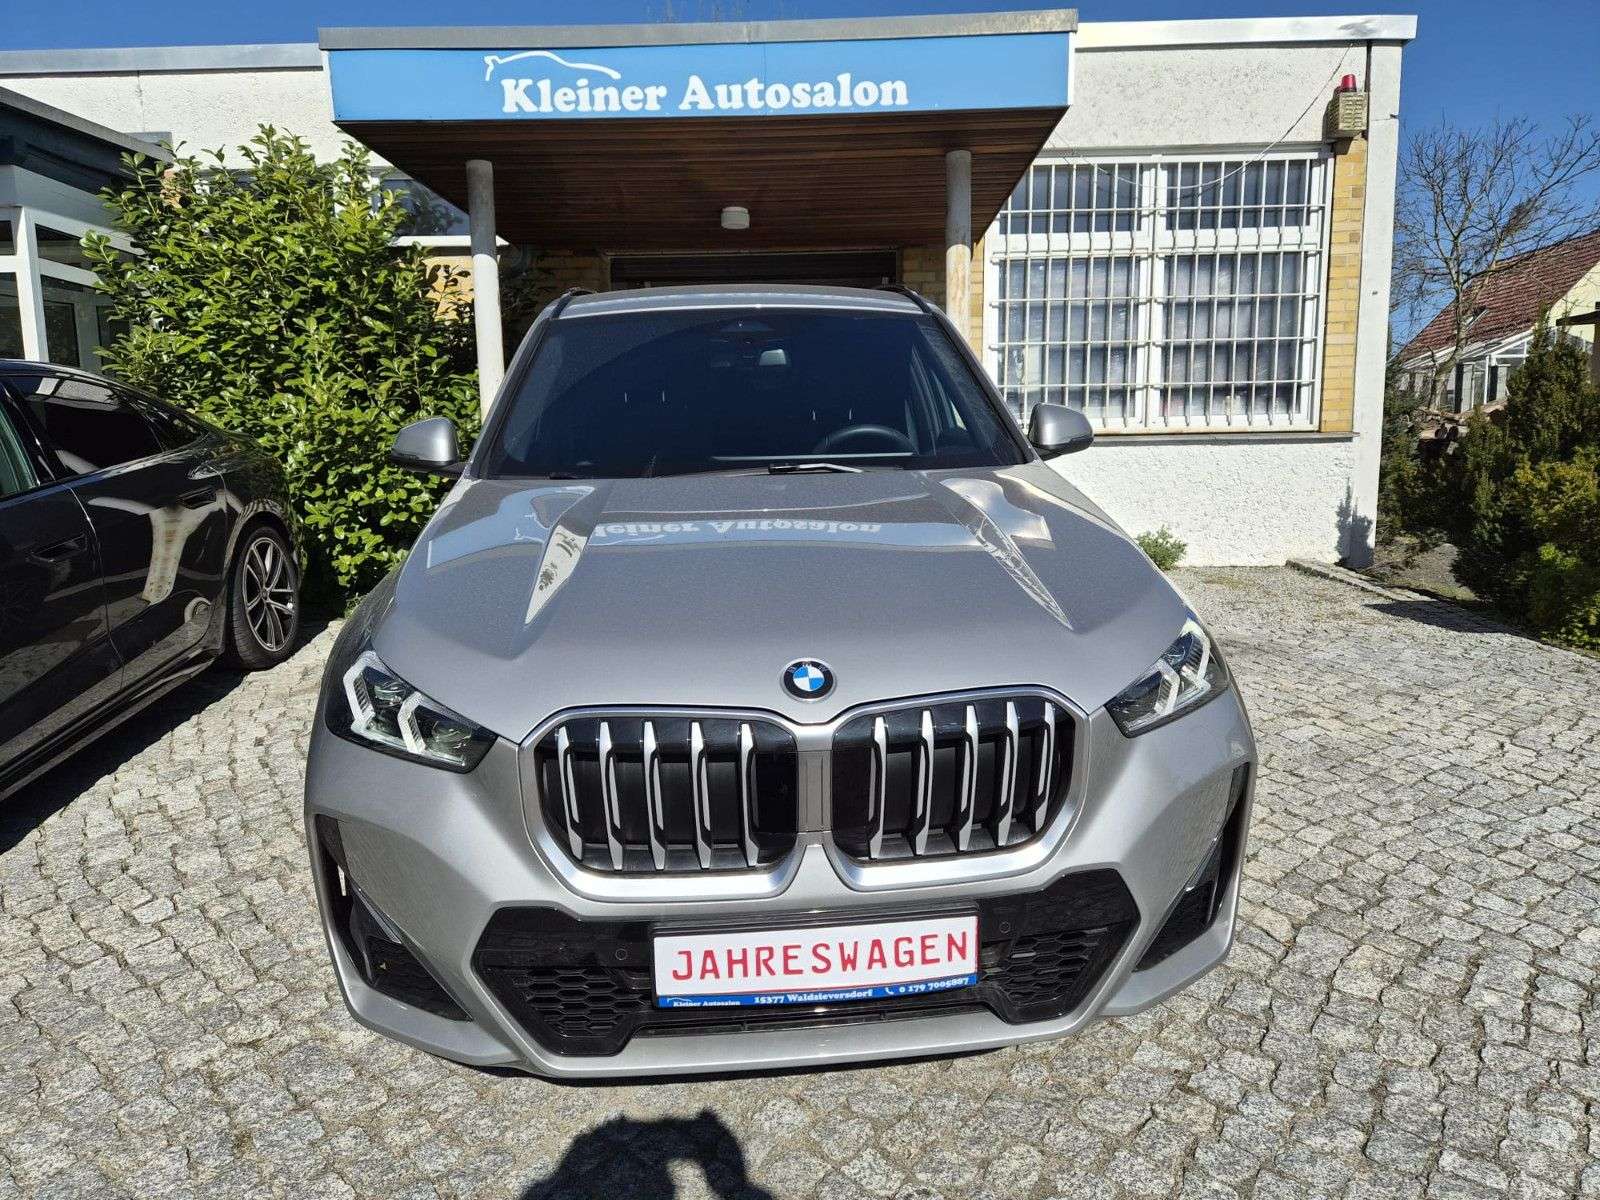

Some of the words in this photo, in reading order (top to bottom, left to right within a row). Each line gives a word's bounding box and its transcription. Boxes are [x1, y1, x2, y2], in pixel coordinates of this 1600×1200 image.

[502, 78, 667, 113] Kleiner
[679, 73, 909, 109] Autosalon
[672, 931, 967, 981] JAHRESWAGEN
[898, 986, 906, 994] 0
